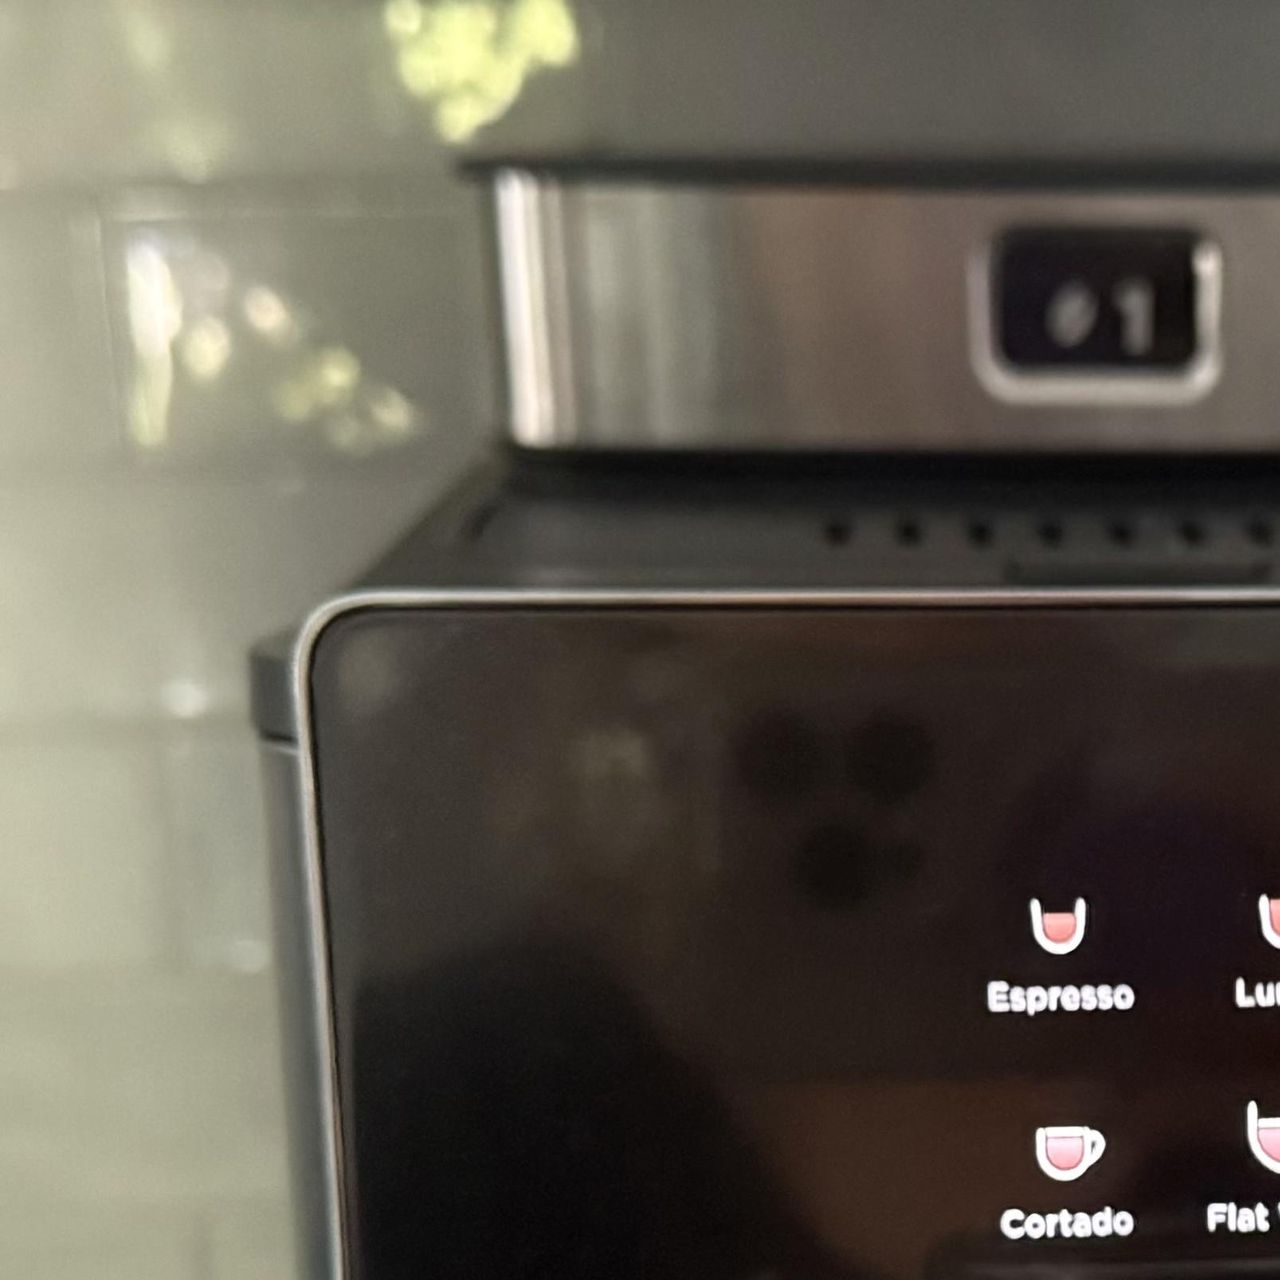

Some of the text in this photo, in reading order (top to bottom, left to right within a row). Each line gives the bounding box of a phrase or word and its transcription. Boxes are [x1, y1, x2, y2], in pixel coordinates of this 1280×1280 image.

[987, 980, 1136, 1017] Espresso
[999, 1205, 1135, 1240] Cortado
[1206, 1201, 1271, 1233] Flat
